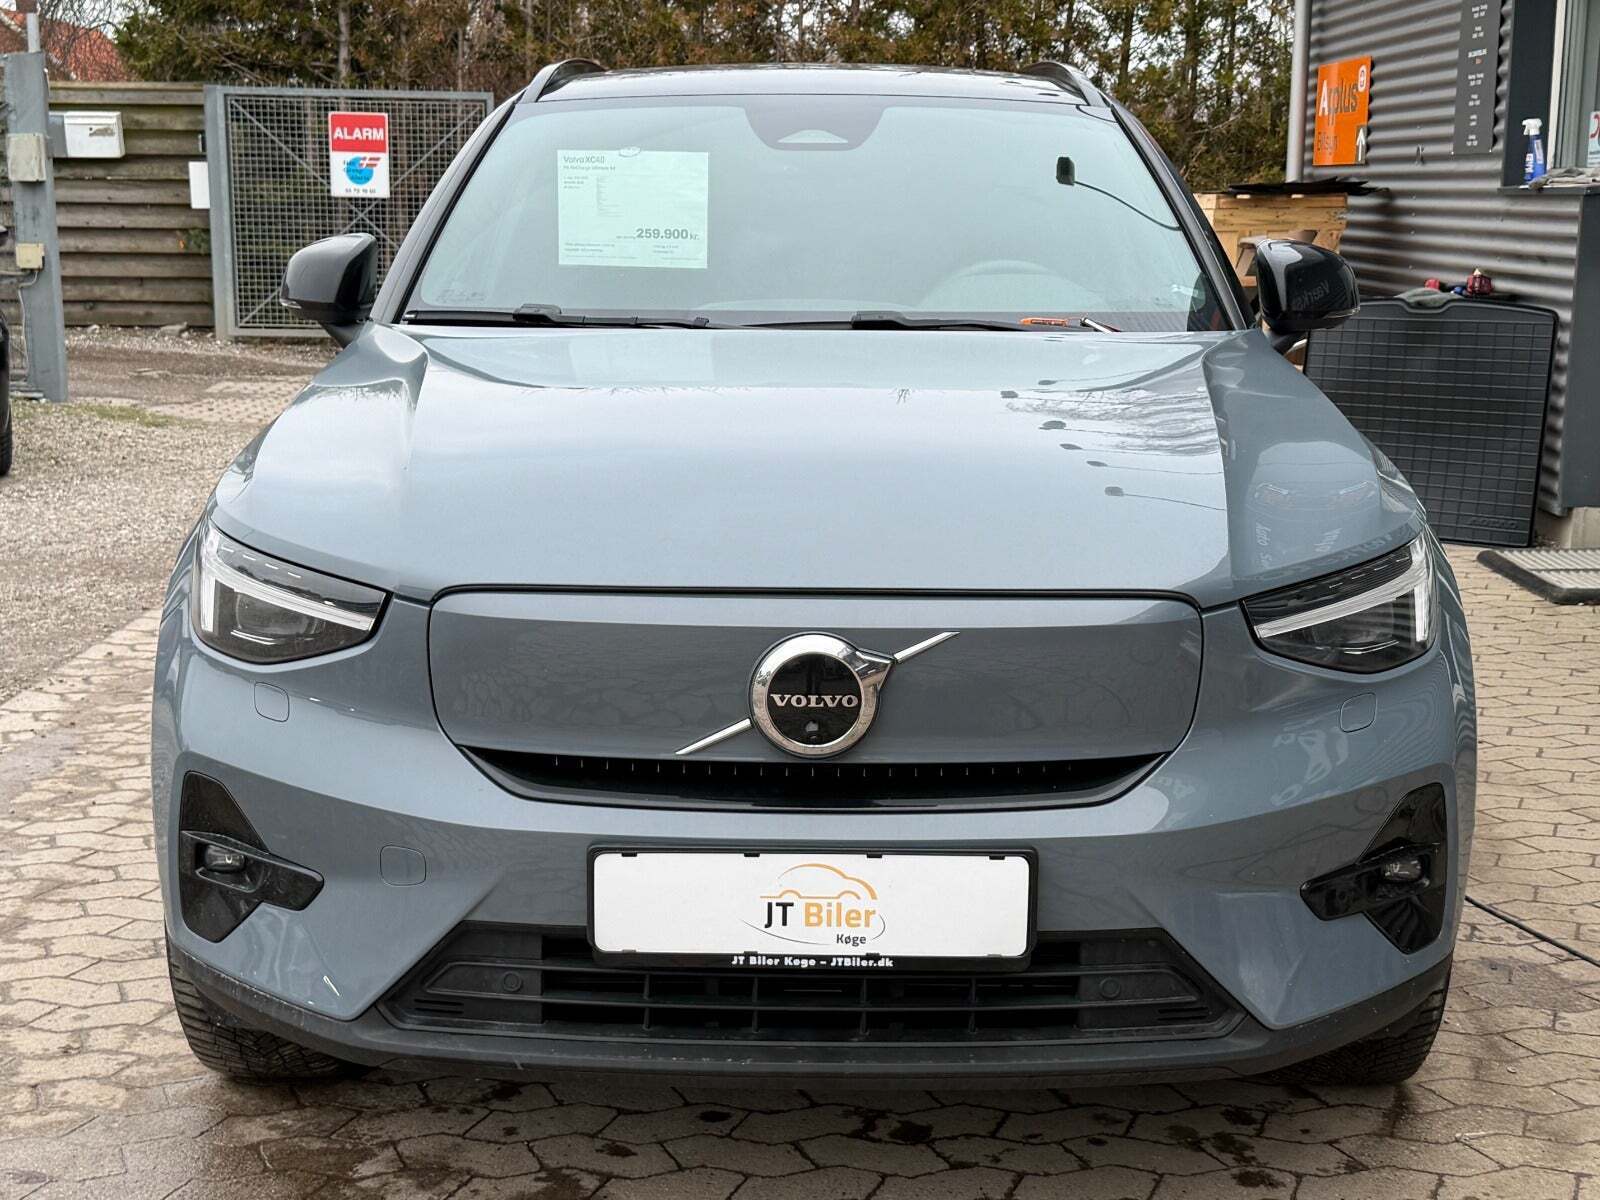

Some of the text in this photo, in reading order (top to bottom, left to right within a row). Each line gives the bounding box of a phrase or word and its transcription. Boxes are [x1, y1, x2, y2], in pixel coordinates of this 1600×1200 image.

[333, 127, 385, 141] ALARM
[636, 228, 689, 240] 259.900
[770, 694, 859, 708] VOLVO
[764, 901, 877, 929] JT Biler
[836, 933, 867, 947] Køge
[731, 955, 745, 965] JT
[749, 955, 780, 966] Biler
[830, 957, 894, 967] JTBiler.dk
